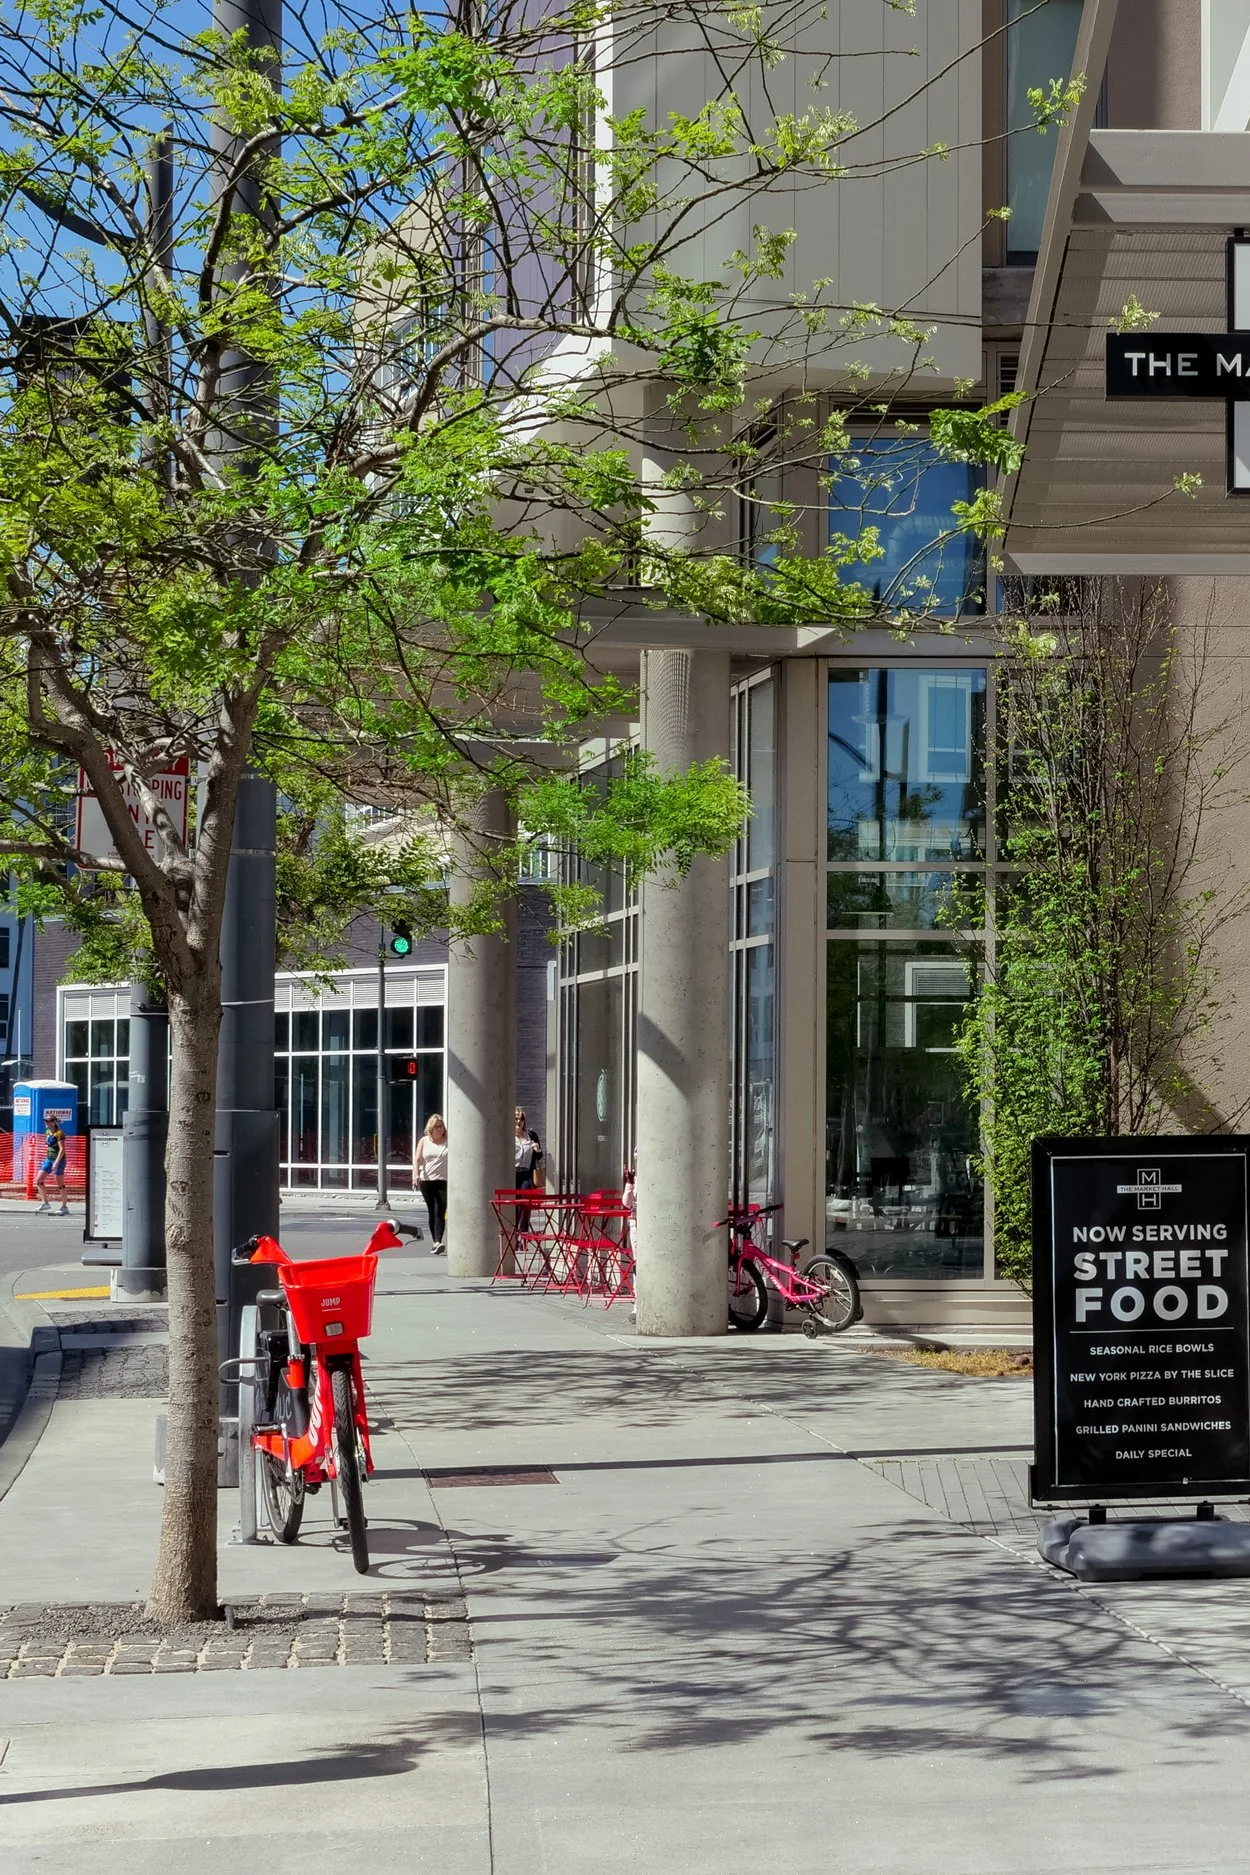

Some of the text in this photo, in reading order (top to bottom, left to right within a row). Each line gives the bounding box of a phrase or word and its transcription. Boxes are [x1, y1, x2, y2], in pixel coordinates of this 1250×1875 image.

[1124, 352, 1199, 377] THE
[1141, 1171, 1156, 1184] M
[1141, 1193, 1157, 1207] H
[1073, 1224, 1227, 1243] NOW SERVING
[1073, 1249, 1229, 1281] STREET
[320, 1296, 341, 1308] JUMP
[1075, 1285, 1229, 1322] FOOD
[1090, 1343, 1215, 1356] SEASONAL RICE BOWLS
[1070, 1368, 1234, 1382] NEW YORK PIZZA BY THE SLICE
[1083, 1395, 1222, 1408] HAND CRAFTED BURRITOS
[1075, 1421, 1231, 1434] GRILLED PANINI SANDWICHES
[1115, 1448, 1192, 1459] DAILY SPECIAL
